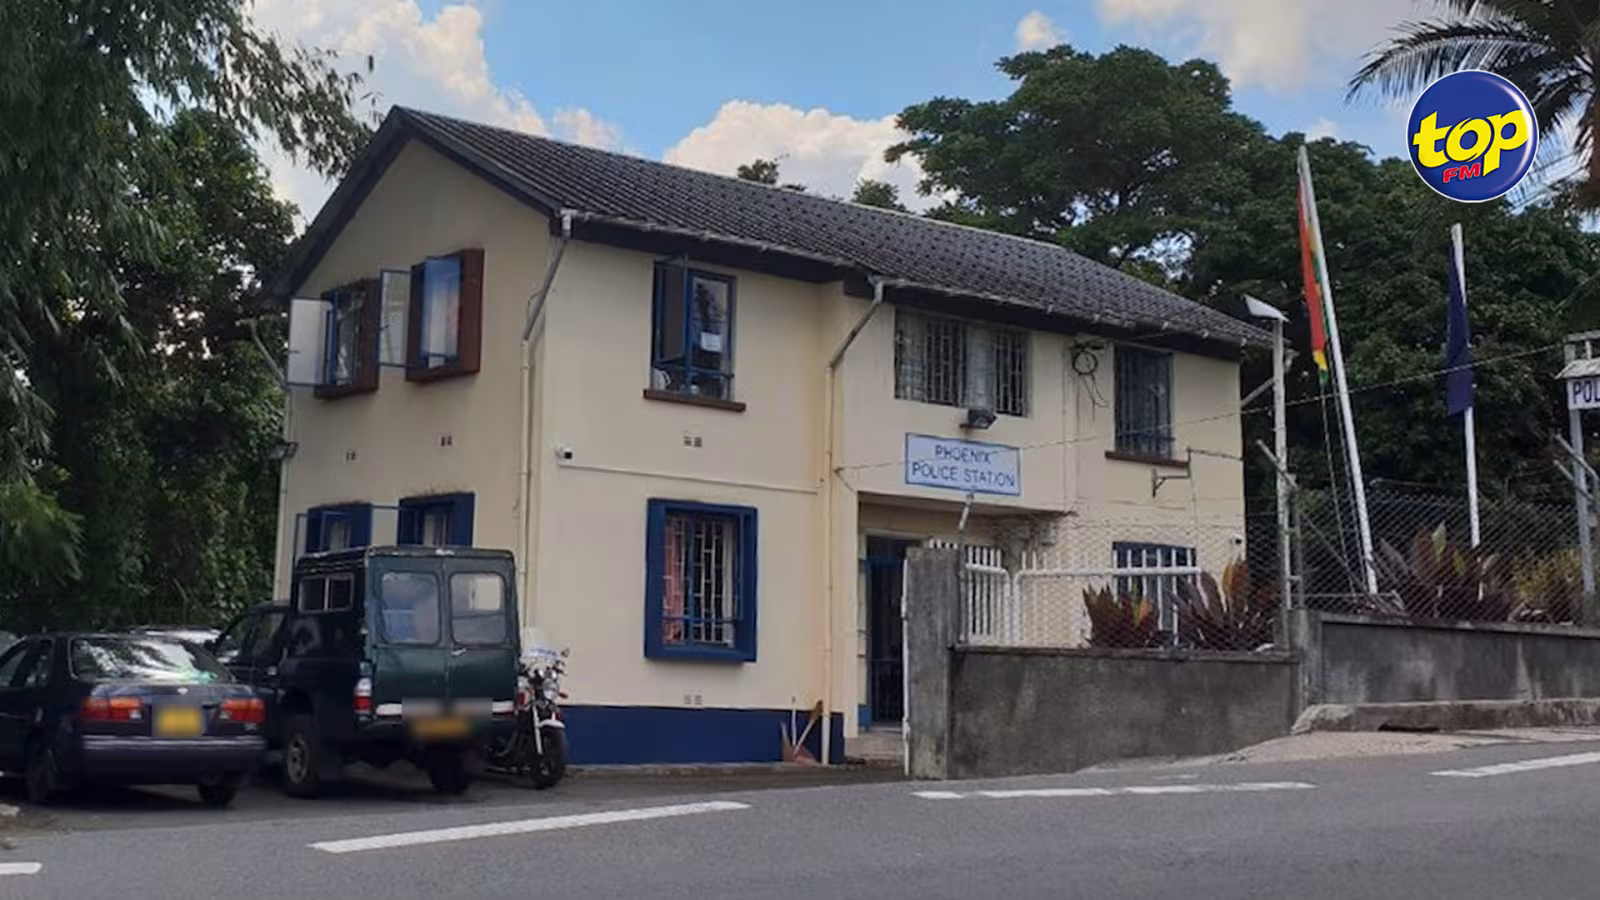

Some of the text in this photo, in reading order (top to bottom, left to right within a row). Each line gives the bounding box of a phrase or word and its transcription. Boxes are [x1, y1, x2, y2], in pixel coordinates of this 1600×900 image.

[935, 445, 993, 464] PHOENIX
[912, 461, 1015, 486] POLICE STATION
